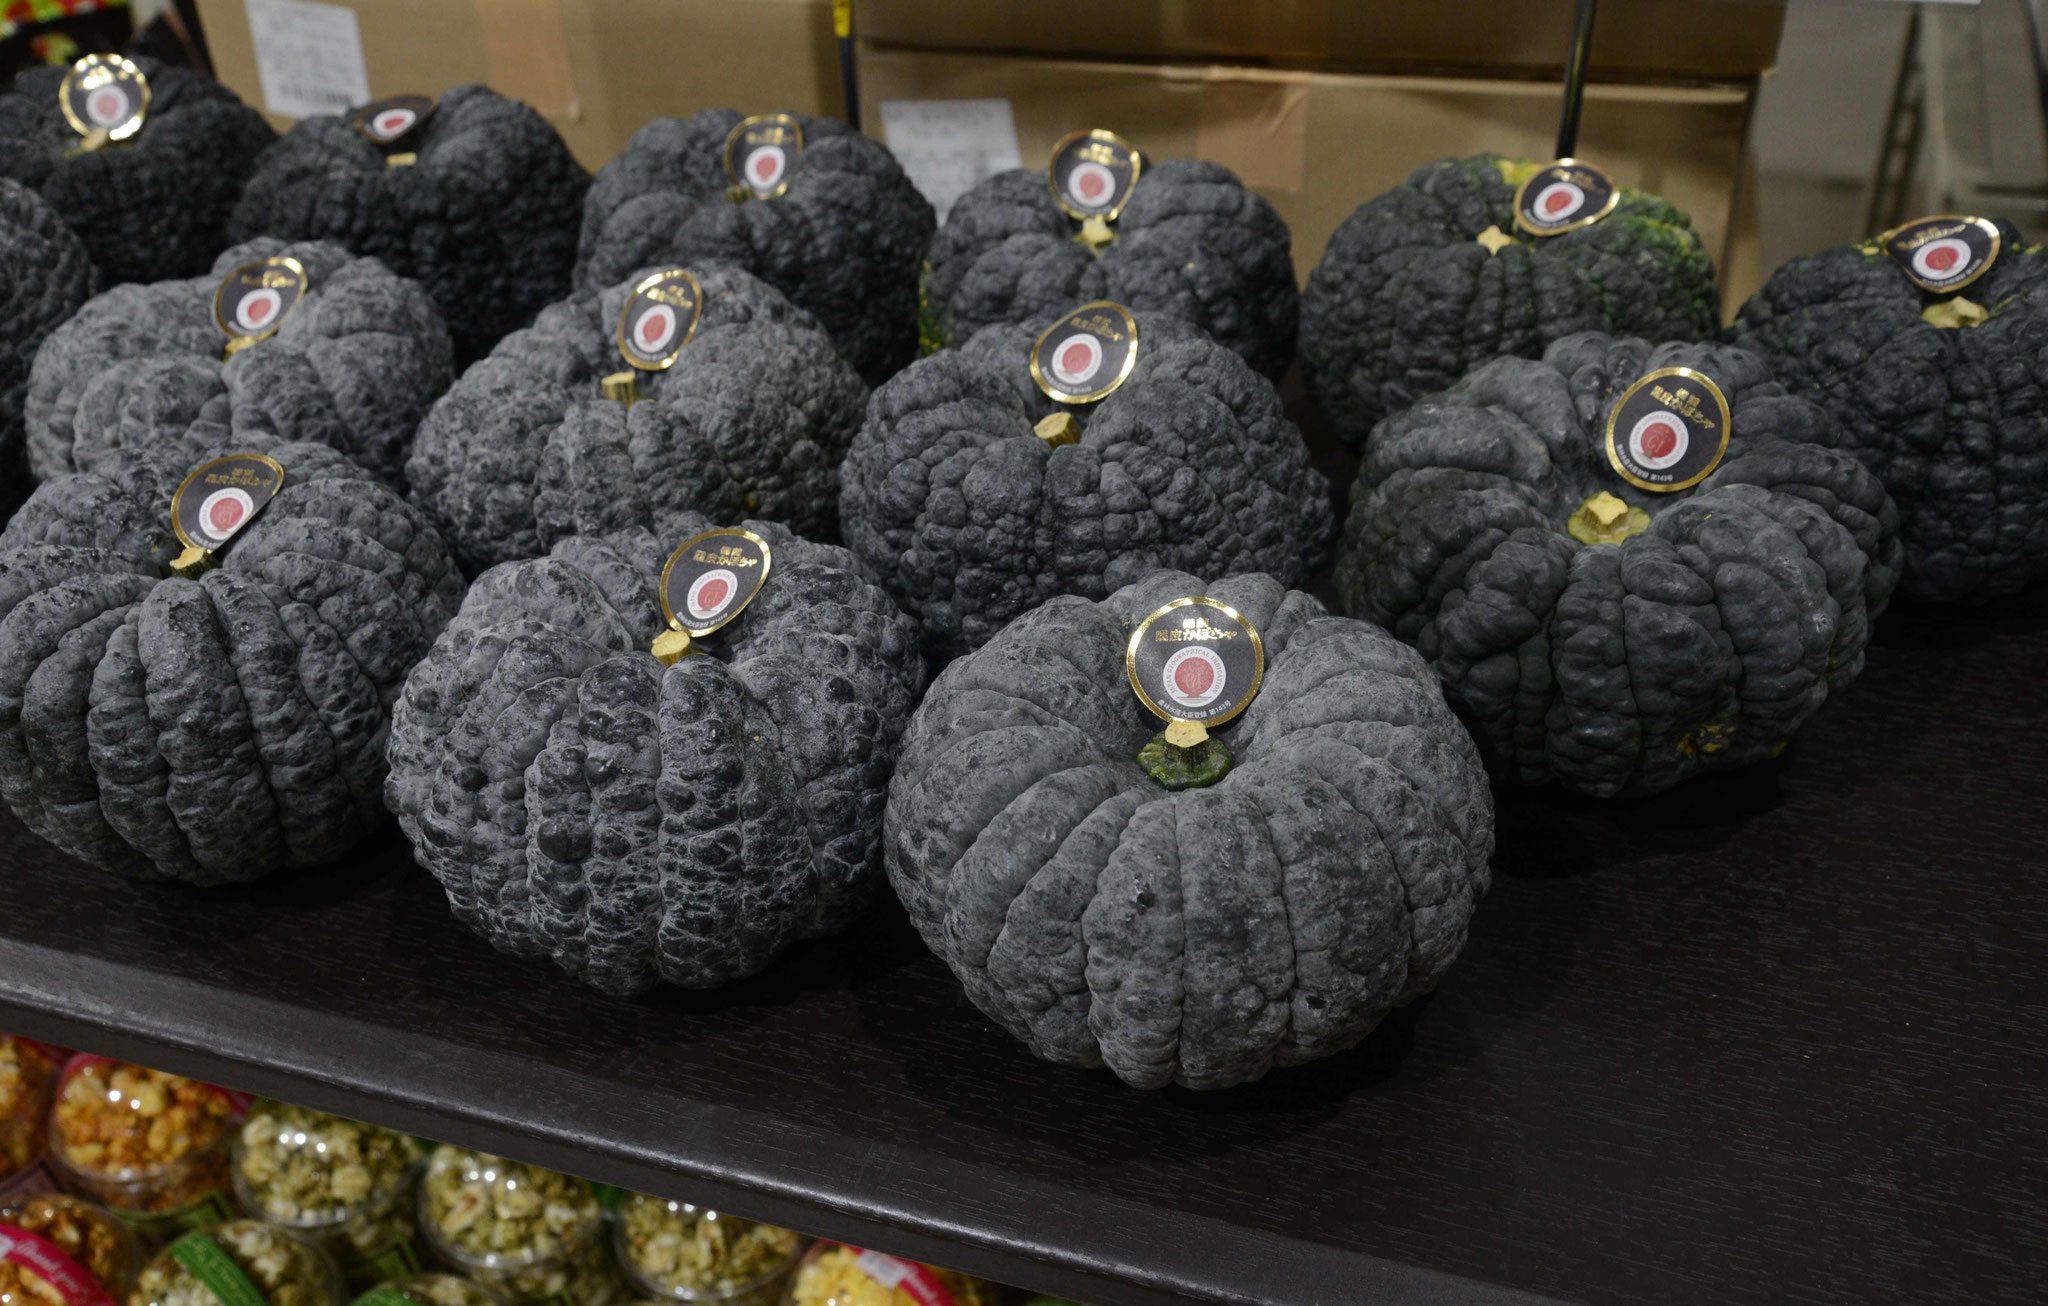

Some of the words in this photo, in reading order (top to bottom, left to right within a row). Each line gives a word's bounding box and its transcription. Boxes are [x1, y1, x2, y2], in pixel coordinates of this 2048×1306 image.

[1155, 626, 1237, 641] 黒皮かぼちゃ
[1166, 648, 1210, 673] GEOGRAPHICAL
